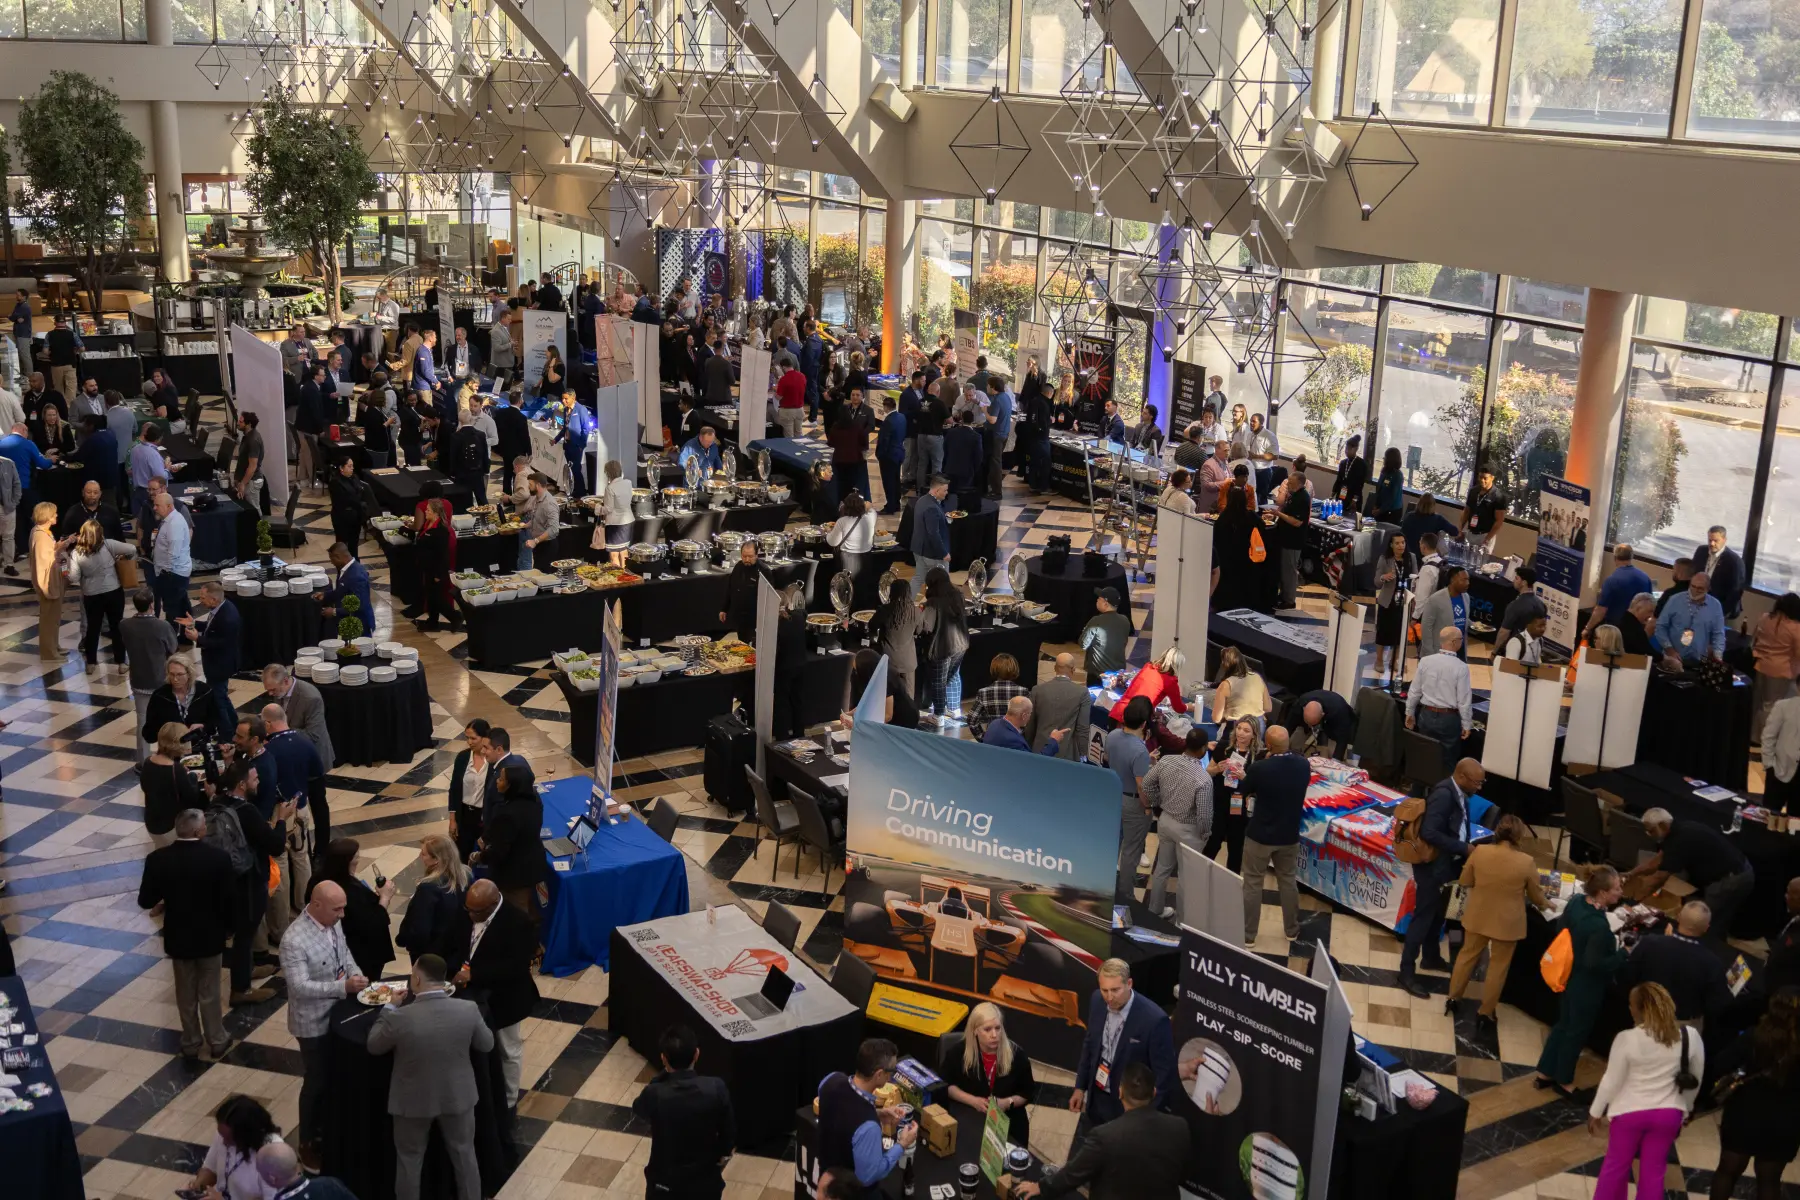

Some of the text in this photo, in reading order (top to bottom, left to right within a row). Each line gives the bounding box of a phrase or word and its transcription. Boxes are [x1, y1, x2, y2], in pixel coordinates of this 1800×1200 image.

[887, 788, 993, 836] Driving
[885, 816, 1072, 874] Communication
[1348, 882, 1388, 909] OWNED
[662, 963, 678, 977] SELL
[704, 1003, 723, 1018] GEAR
[1189, 951, 1318, 1025] TALLY TUMBLER
[1186, 989, 1315, 1056] STAINLESS STEEL SCOREKEEPING TUMBLER
[1196, 1012, 1226, 1034] PLAY
[1233, 1029, 1252, 1046] SIP
[1261, 1043, 1303, 1072] SCORE
